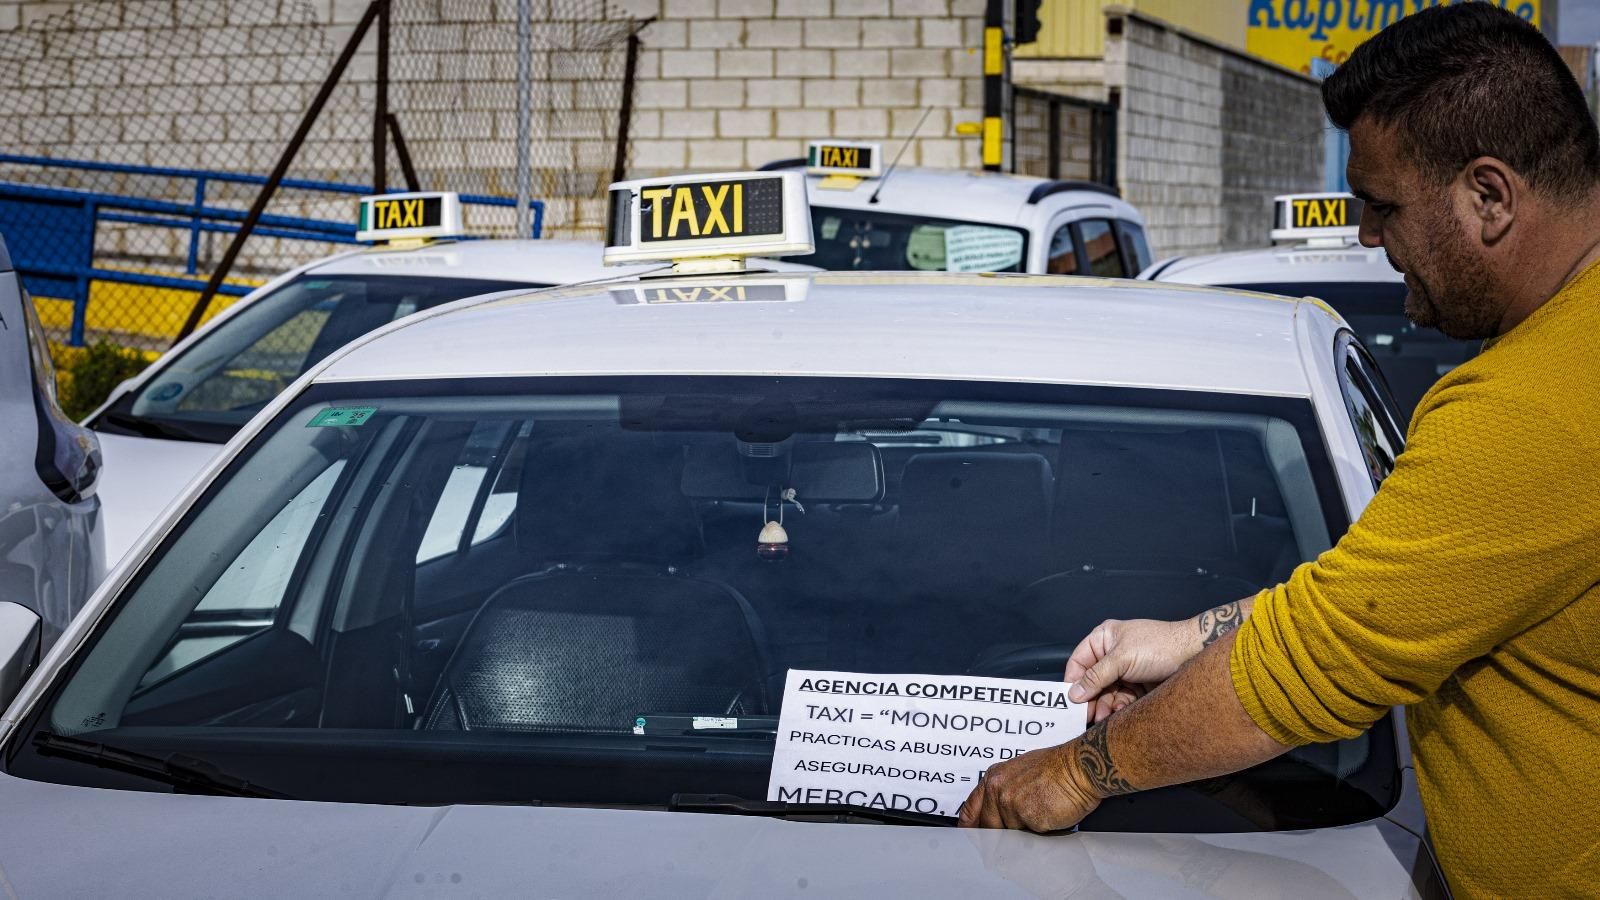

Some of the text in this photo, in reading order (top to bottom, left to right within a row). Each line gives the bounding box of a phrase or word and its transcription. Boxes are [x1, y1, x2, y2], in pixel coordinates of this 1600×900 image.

[822, 147, 858, 167] TAXI
[375, 199, 424, 228] TAXI
[642, 184, 743, 238] TAXI
[1293, 199, 1346, 227] TAXI
[799, 678, 1068, 709] AGENCIA COMPETENCIA
[806, 704, 854, 722] TAXI
[790, 730, 896, 751] PRACTICAS
[900, 741, 994, 759] ABUSIVAS
[794, 759, 955, 783] ASEGURADORAS
